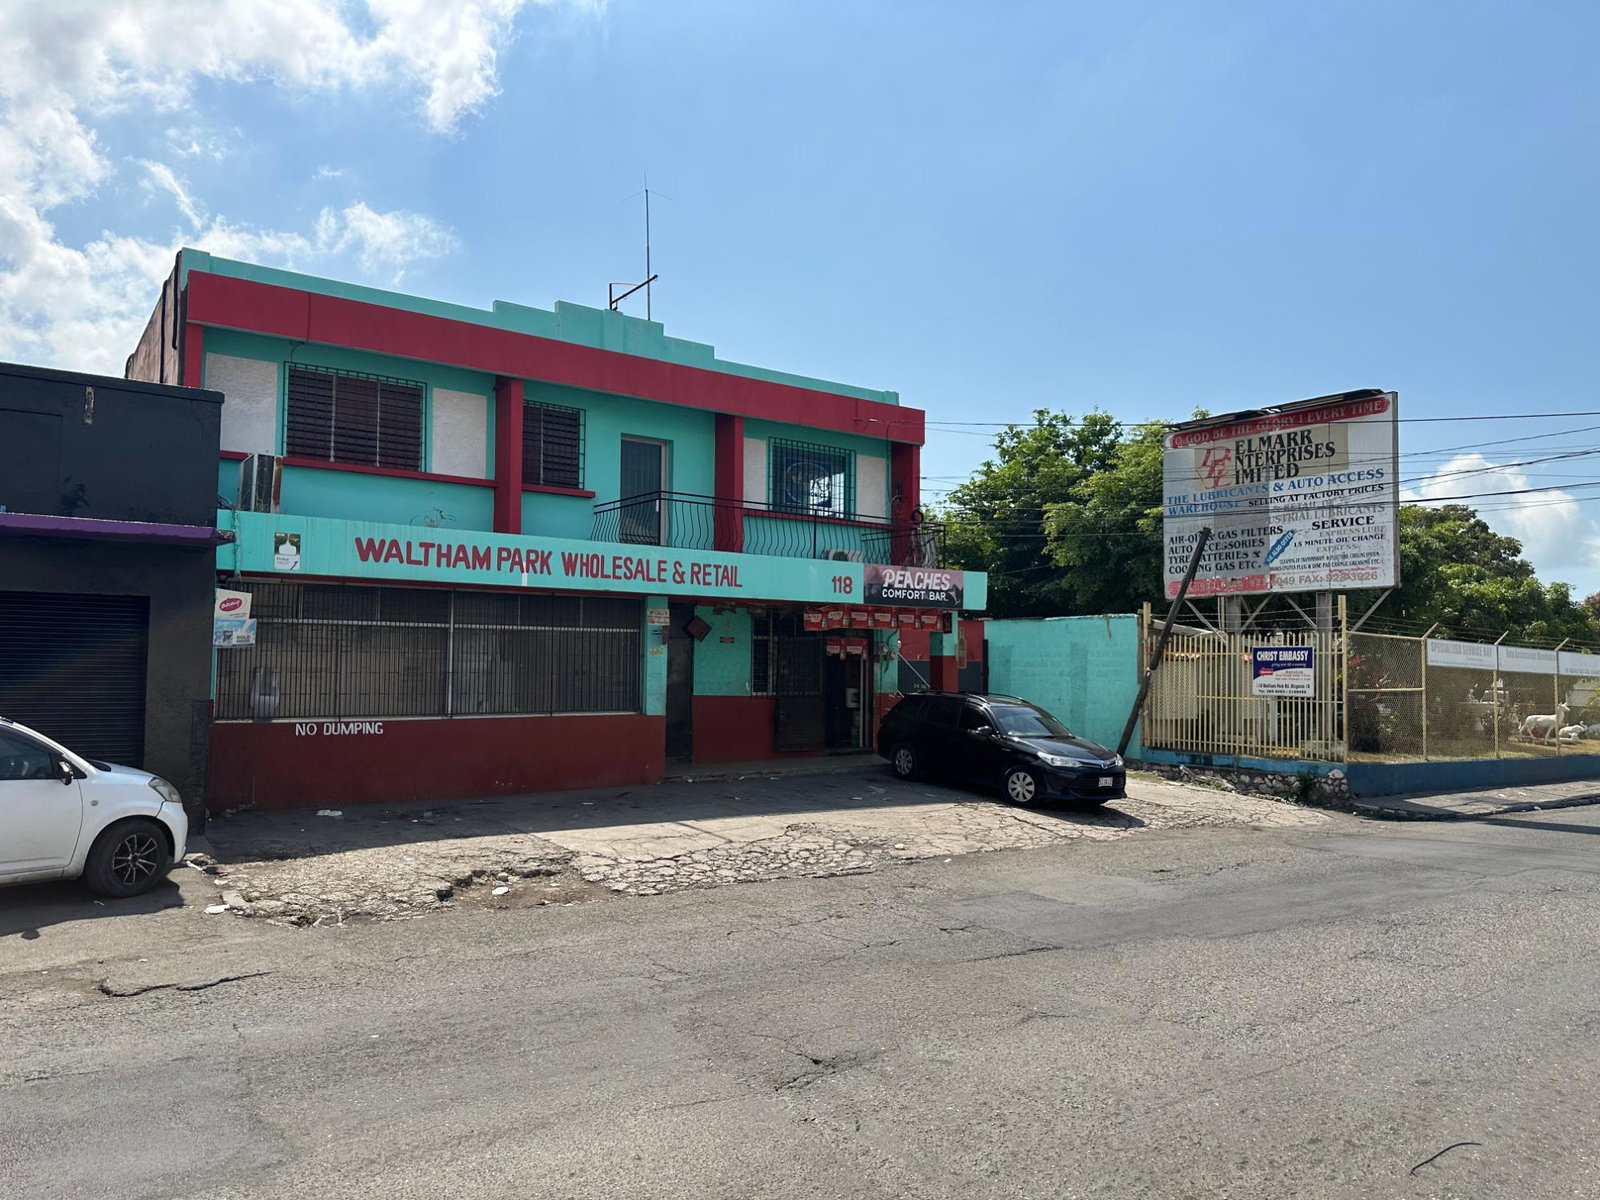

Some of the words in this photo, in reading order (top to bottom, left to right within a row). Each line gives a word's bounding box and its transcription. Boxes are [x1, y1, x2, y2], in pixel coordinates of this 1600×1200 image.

[1186, 432, 1209, 444] GOD
[1213, 429, 1227, 438] BE
[1231, 424, 1250, 435] THE
[1307, 407, 1346, 422] EVERY
[1351, 401, 1383, 415] TIME
[1235, 430, 1313, 455] ELMARR
[1235, 441, 1336, 469] NTERPRISES
[1167, 495, 1188, 505] THE
[1193, 484, 1269, 502] LUBRICANTS
[1273, 482, 1284, 491] &
[1288, 477, 1324, 490] AUTO
[1328, 468, 1384, 485] ACCESS
[1168, 501, 1240, 516] WAREHOUSE
[1249, 496, 1286, 507] SELLING
[1289, 494, 1300, 502] AT
[1304, 489, 1344, 501] FACTORY
[1348, 484, 1384, 494] PRICES
[1314, 504, 1385, 520] LUBRICANTS
[1311, 515, 1376, 530] SERVICE
[1218, 530, 1237, 540] GAS
[1241, 525, 1283, 537] FILTERS
[1305, 539, 1331, 547] MINUTE
[1351, 533, 1385, 542] CHANGE
[1319, 527, 1362, 538] EXPRESS
[1363, 526, 1385, 534] LUBE
[1168, 545, 1193, 555] AUTO
[1203, 538, 1265, 552] CCESSORIES
[354, 537, 491, 571] WALTHAM
[496, 547, 553, 576] PARK
[560, 551, 667, 583] WHOLESALE
[672, 560, 686, 585] &
[690, 563, 743, 588] RETAIL
[1199, 551, 1249, 562] ATTERIES
[1215, 562, 1235, 571] GAS
[1238, 561, 1262, 570] ETC.
[832, 576, 853, 595] 118
[882, 569, 951, 590] PEACHES
[882, 589, 926, 600] COMFORT
[929, 591, 949, 601] BAR
[1256, 650, 1278, 661] CHRIST
[1279, 650, 1309, 661] EMBASSY
[295, 722, 318, 736] NO
[323, 721, 384, 736] DUMPING
